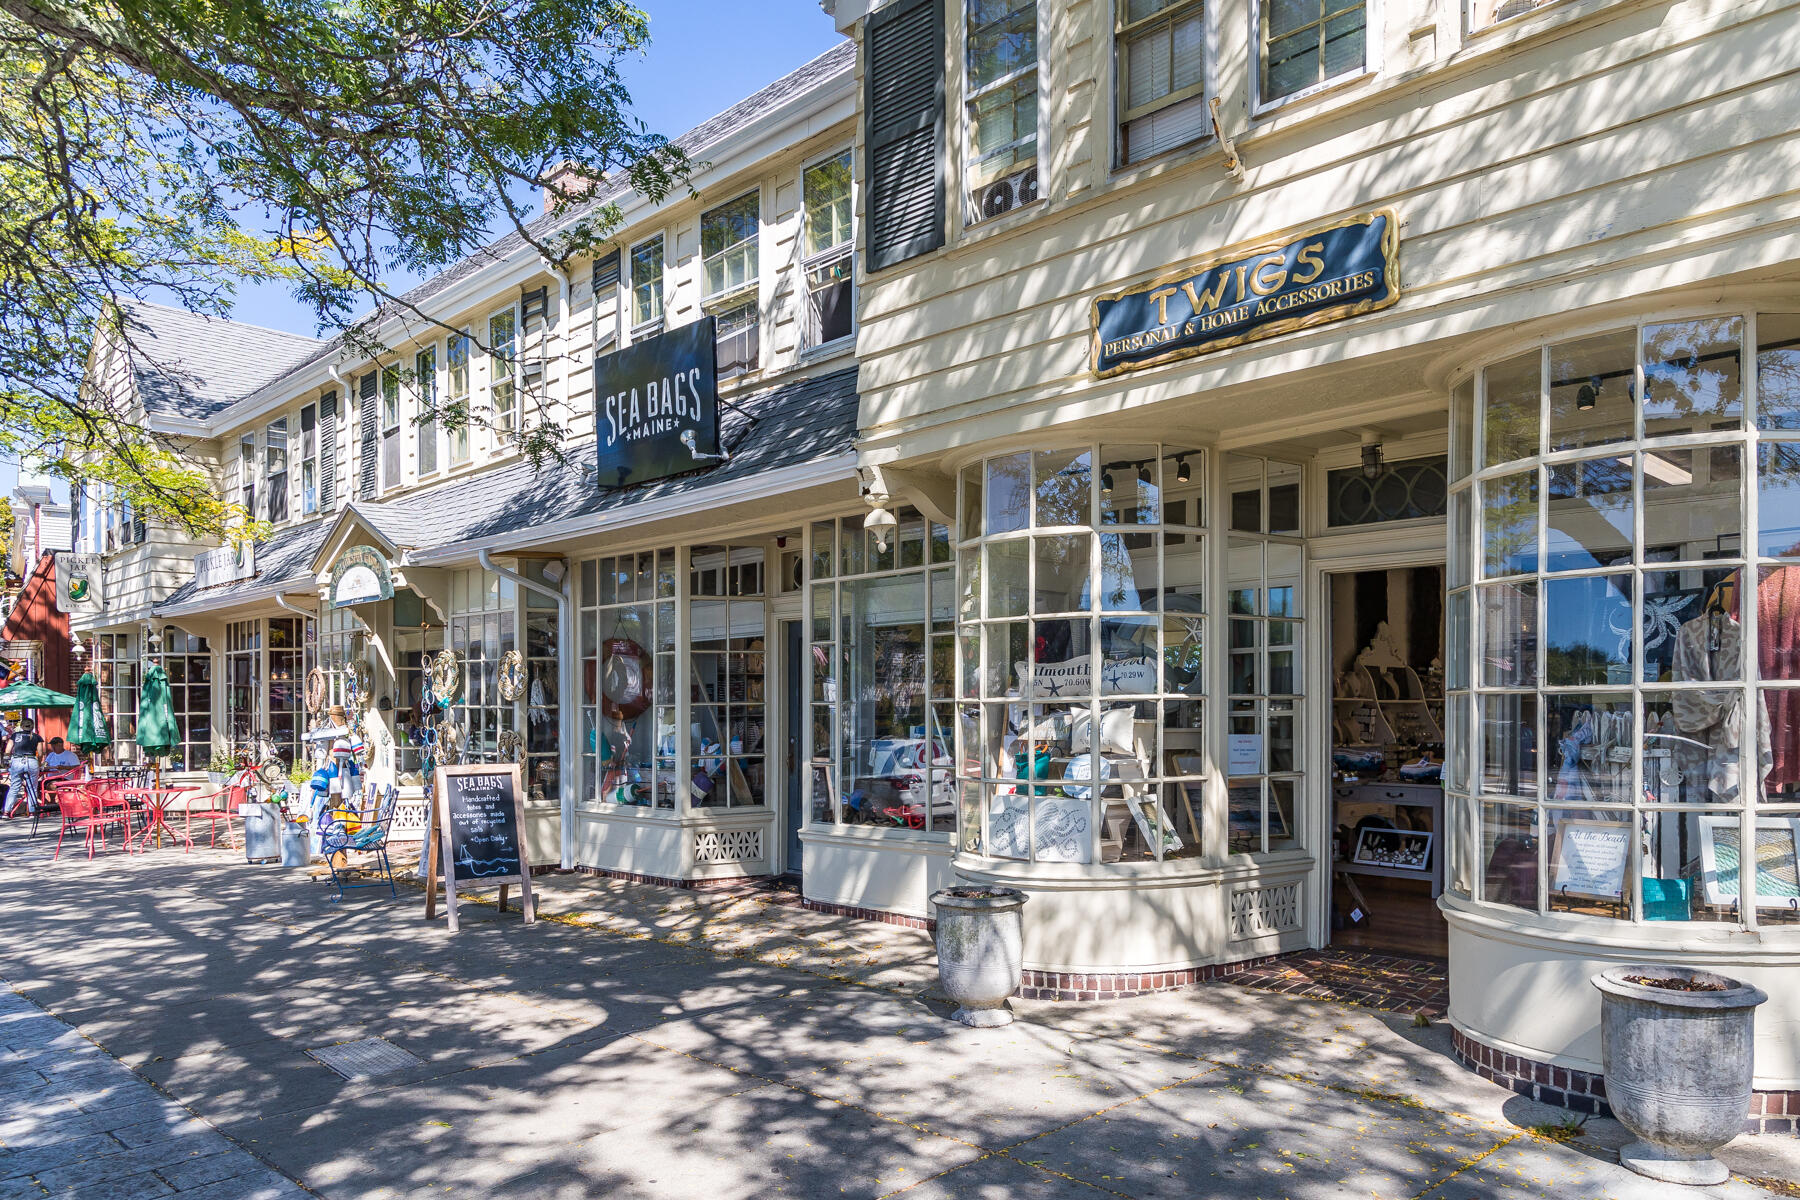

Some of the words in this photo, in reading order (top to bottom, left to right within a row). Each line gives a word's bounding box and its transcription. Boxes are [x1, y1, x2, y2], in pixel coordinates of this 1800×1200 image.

[1149, 241, 1324, 325] TWIGS
[1104, 326, 1181, 357] PERSONAL
[1184, 321, 1196, 336] &
[1200, 305, 1250, 332] HOME
[1255, 271, 1375, 317] ACCESSORIES
[605, 387, 641, 447] SEA
[647, 367, 701, 422] BAGS
[633, 418, 673, 440] MAINE
[60, 556, 97, 564] PICKLE
[200, 554, 222, 573] PICKLE
[223, 551, 236, 570] JAR
[457, 777, 475, 792] SEA
[477, 775, 504, 790] BAGS
[462, 795, 500, 803] Handcrafted
[481, 818, 505, 827] recycled
[1583, 831, 1597, 840] the
[1599, 831, 1628, 843] Beach
